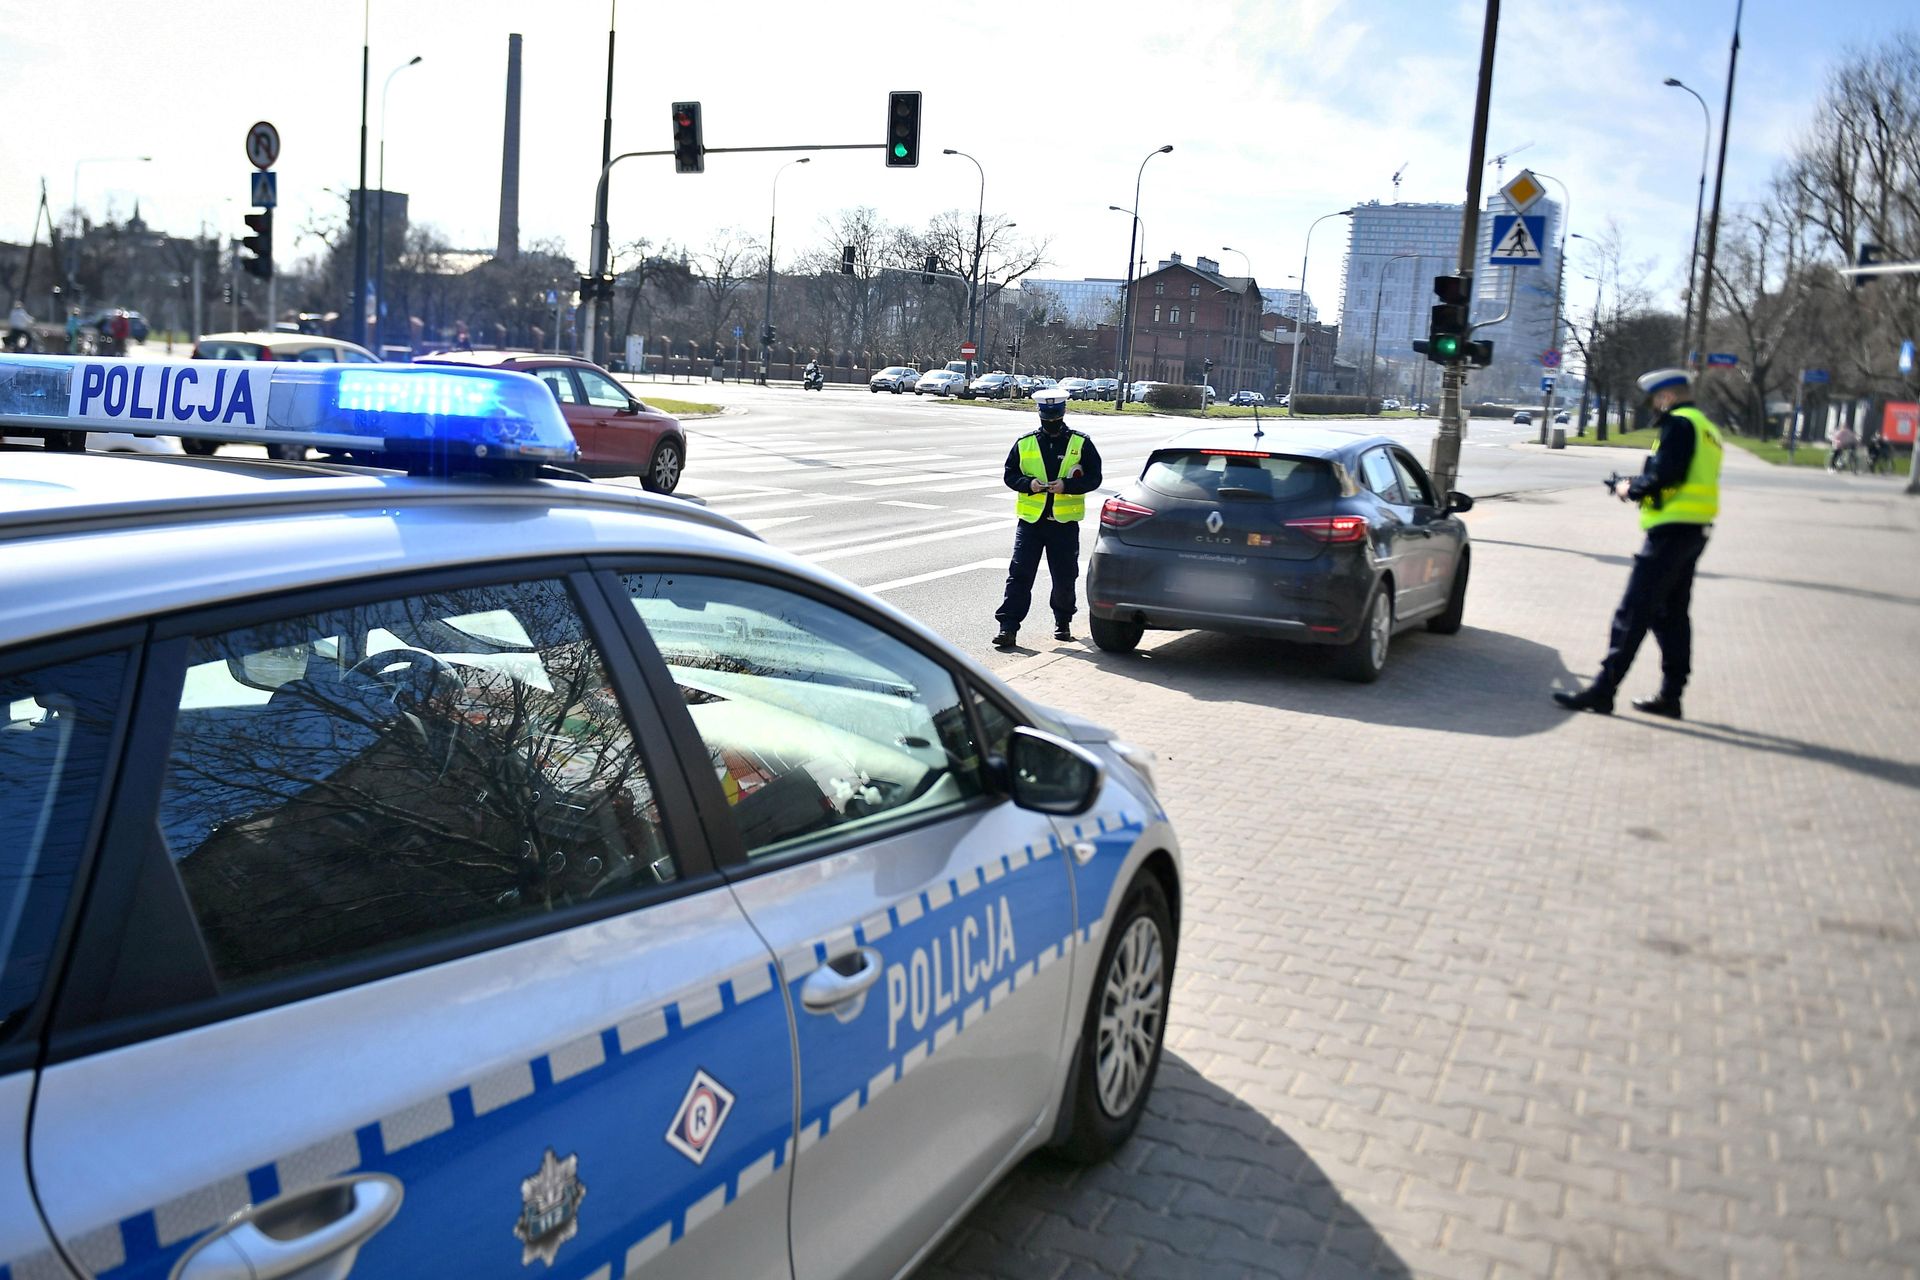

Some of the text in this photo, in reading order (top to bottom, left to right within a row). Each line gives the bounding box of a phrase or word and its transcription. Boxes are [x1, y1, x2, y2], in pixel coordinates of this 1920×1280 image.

[79, 364, 256, 425] POLICJA
[1195, 535, 1232, 545] CLIO
[887, 896, 1016, 1051] POLICJA
[696, 1105, 707, 1132] R
